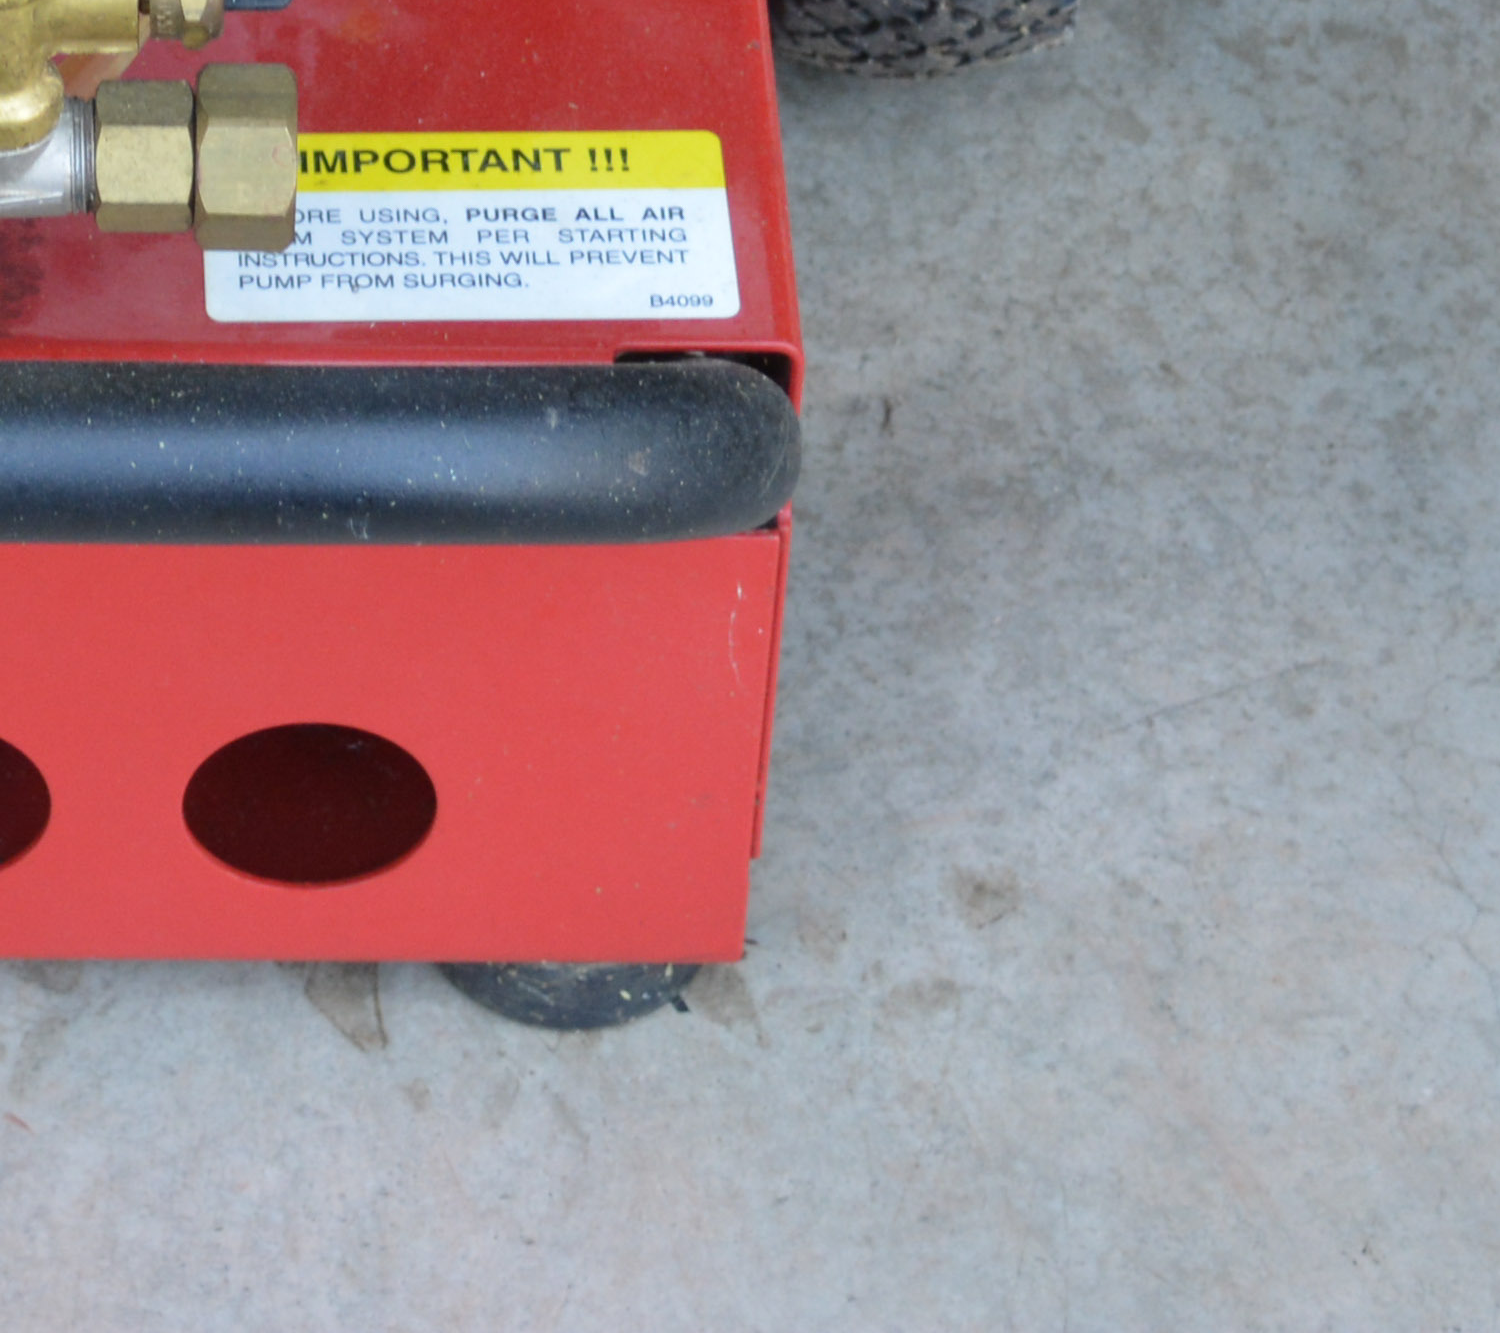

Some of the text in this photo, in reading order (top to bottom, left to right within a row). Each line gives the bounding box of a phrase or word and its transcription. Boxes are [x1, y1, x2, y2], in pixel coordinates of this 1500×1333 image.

[299, 147, 630, 174] IMPORTANT !!!
[359, 207, 448, 225] USING,
[466, 206, 557, 223] PURGE
[575, 206, 624, 222] ALL
[642, 205, 685, 221] AIR
[341, 227, 687, 246] SYSTEM PER STARTING
[237, 249, 689, 268] INSTRUCTIONS. THIS WILL PREVENT
[239, 272, 529, 290] PUMP FROM SURGING.
[650, 293, 714, 309] B4099
